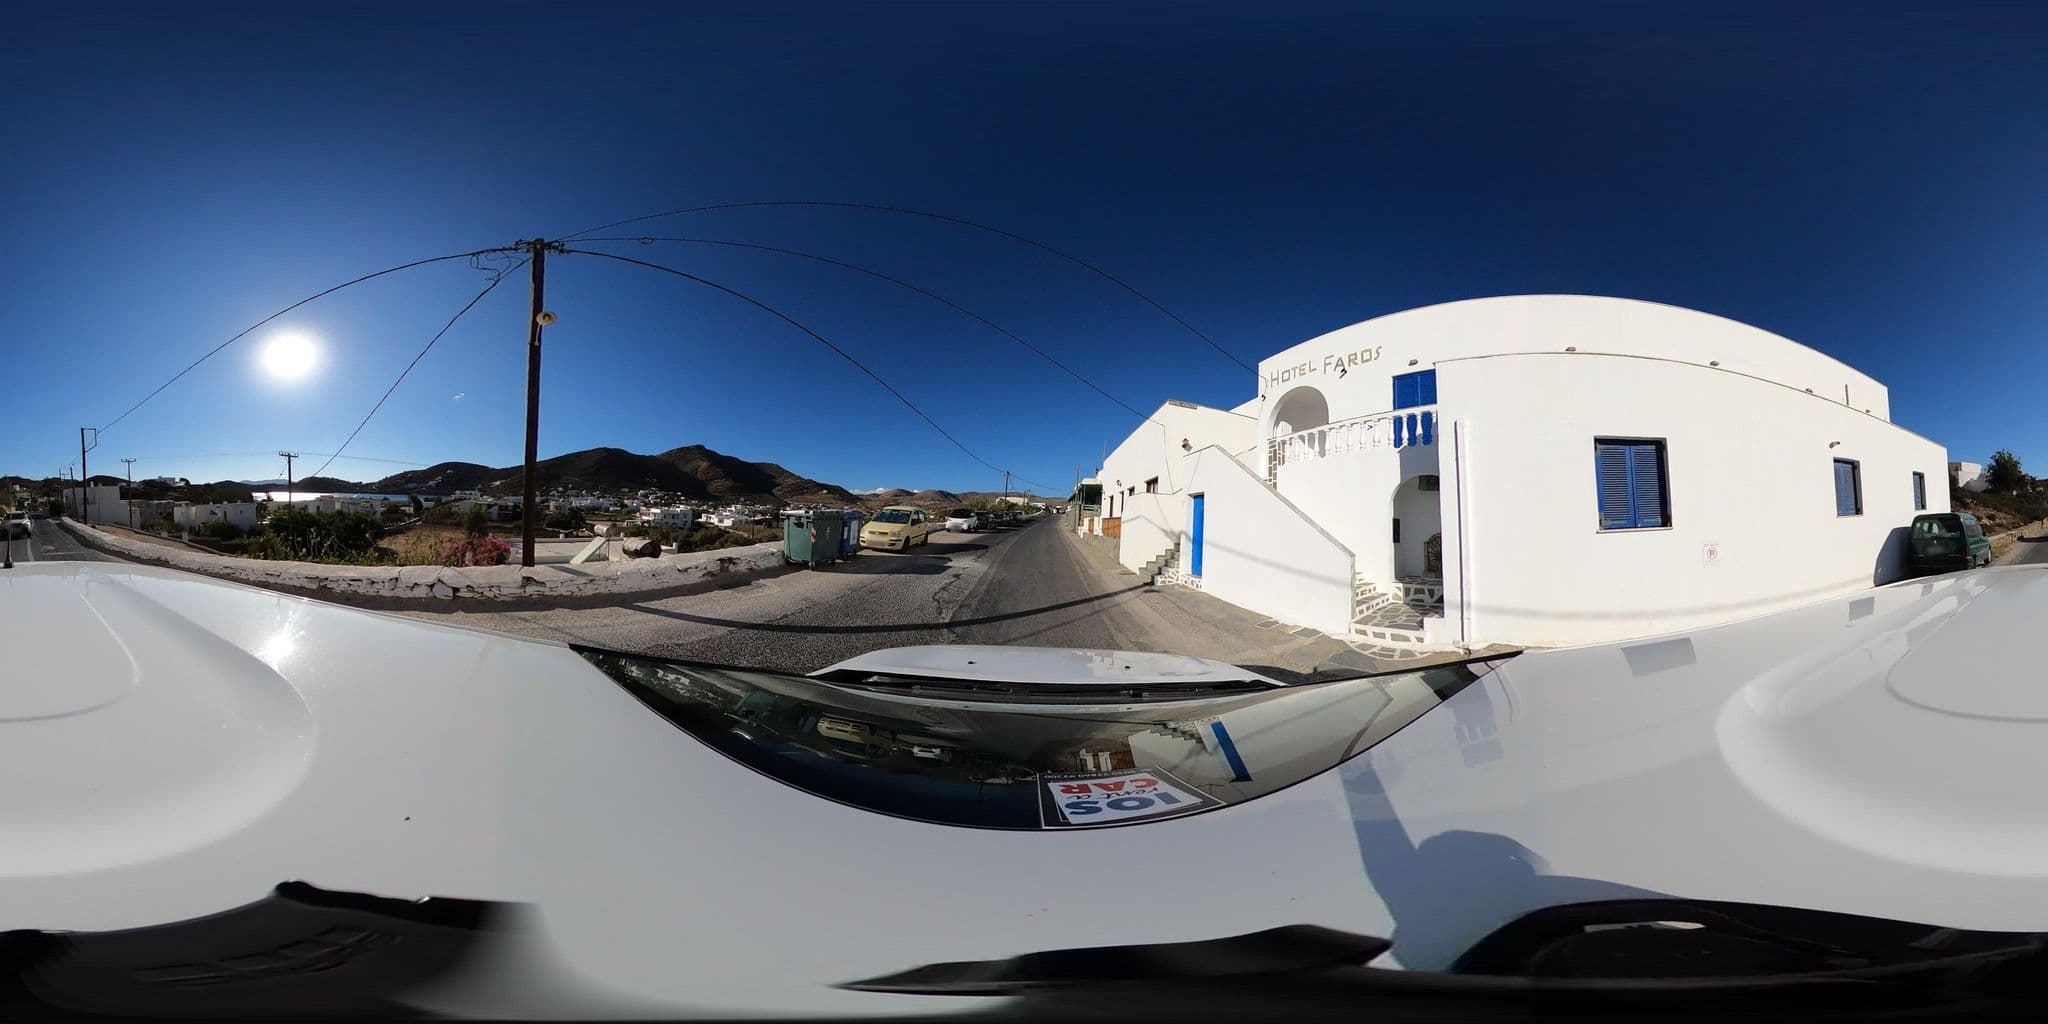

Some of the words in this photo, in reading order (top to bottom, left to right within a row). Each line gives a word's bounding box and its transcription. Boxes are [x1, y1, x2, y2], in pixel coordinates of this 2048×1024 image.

[1270, 360, 1317, 387] HOTEL
[1323, 345, 1382, 374] FAROS
[1059, 778, 1160, 794] CAR
[1099, 787, 1159, 800] rent
[1064, 792, 1182, 815] IOS
